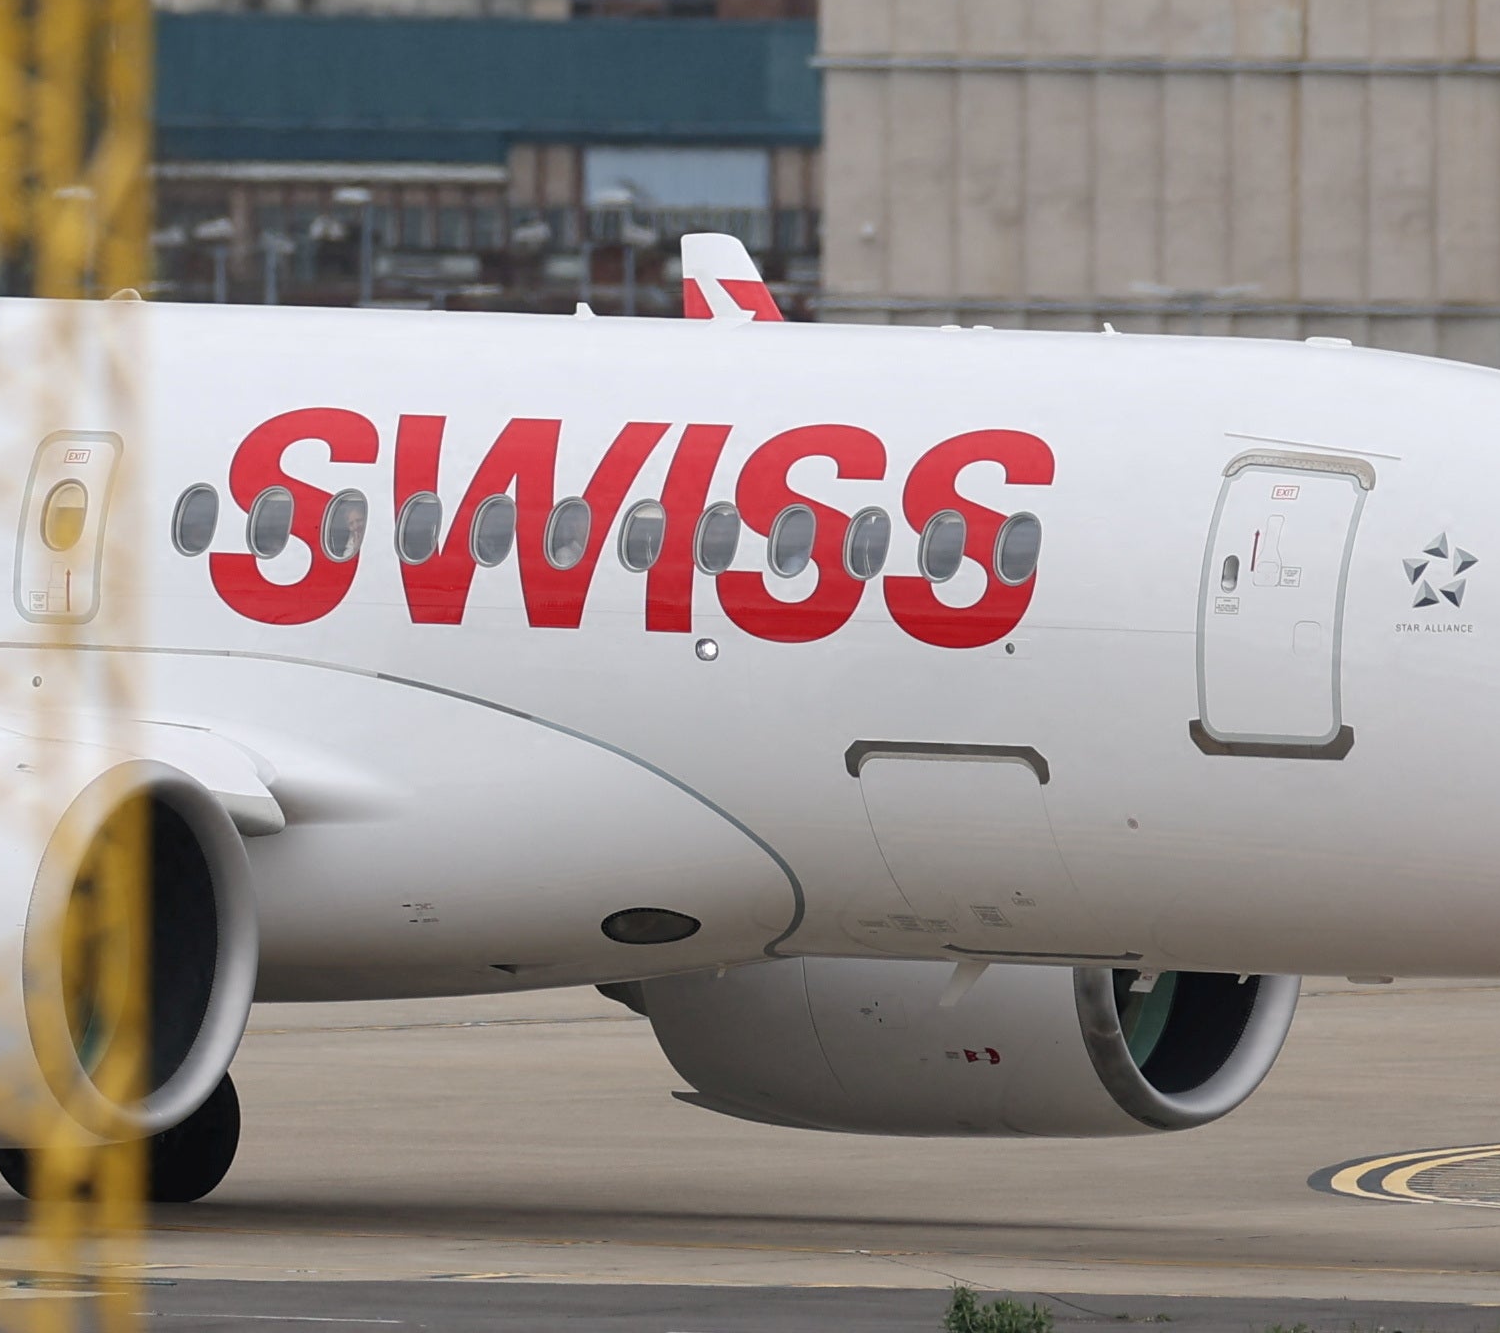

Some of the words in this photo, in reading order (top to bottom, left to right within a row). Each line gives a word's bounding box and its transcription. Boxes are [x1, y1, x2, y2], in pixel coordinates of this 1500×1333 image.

[68, 452, 87, 461] EXIT
[1275, 488, 1296, 497] EXIT
[209, 407, 1055, 650] SWISS
[1395, 623, 1420, 633] STAR
[1424, 624, 1474, 633] ALLIANCE
